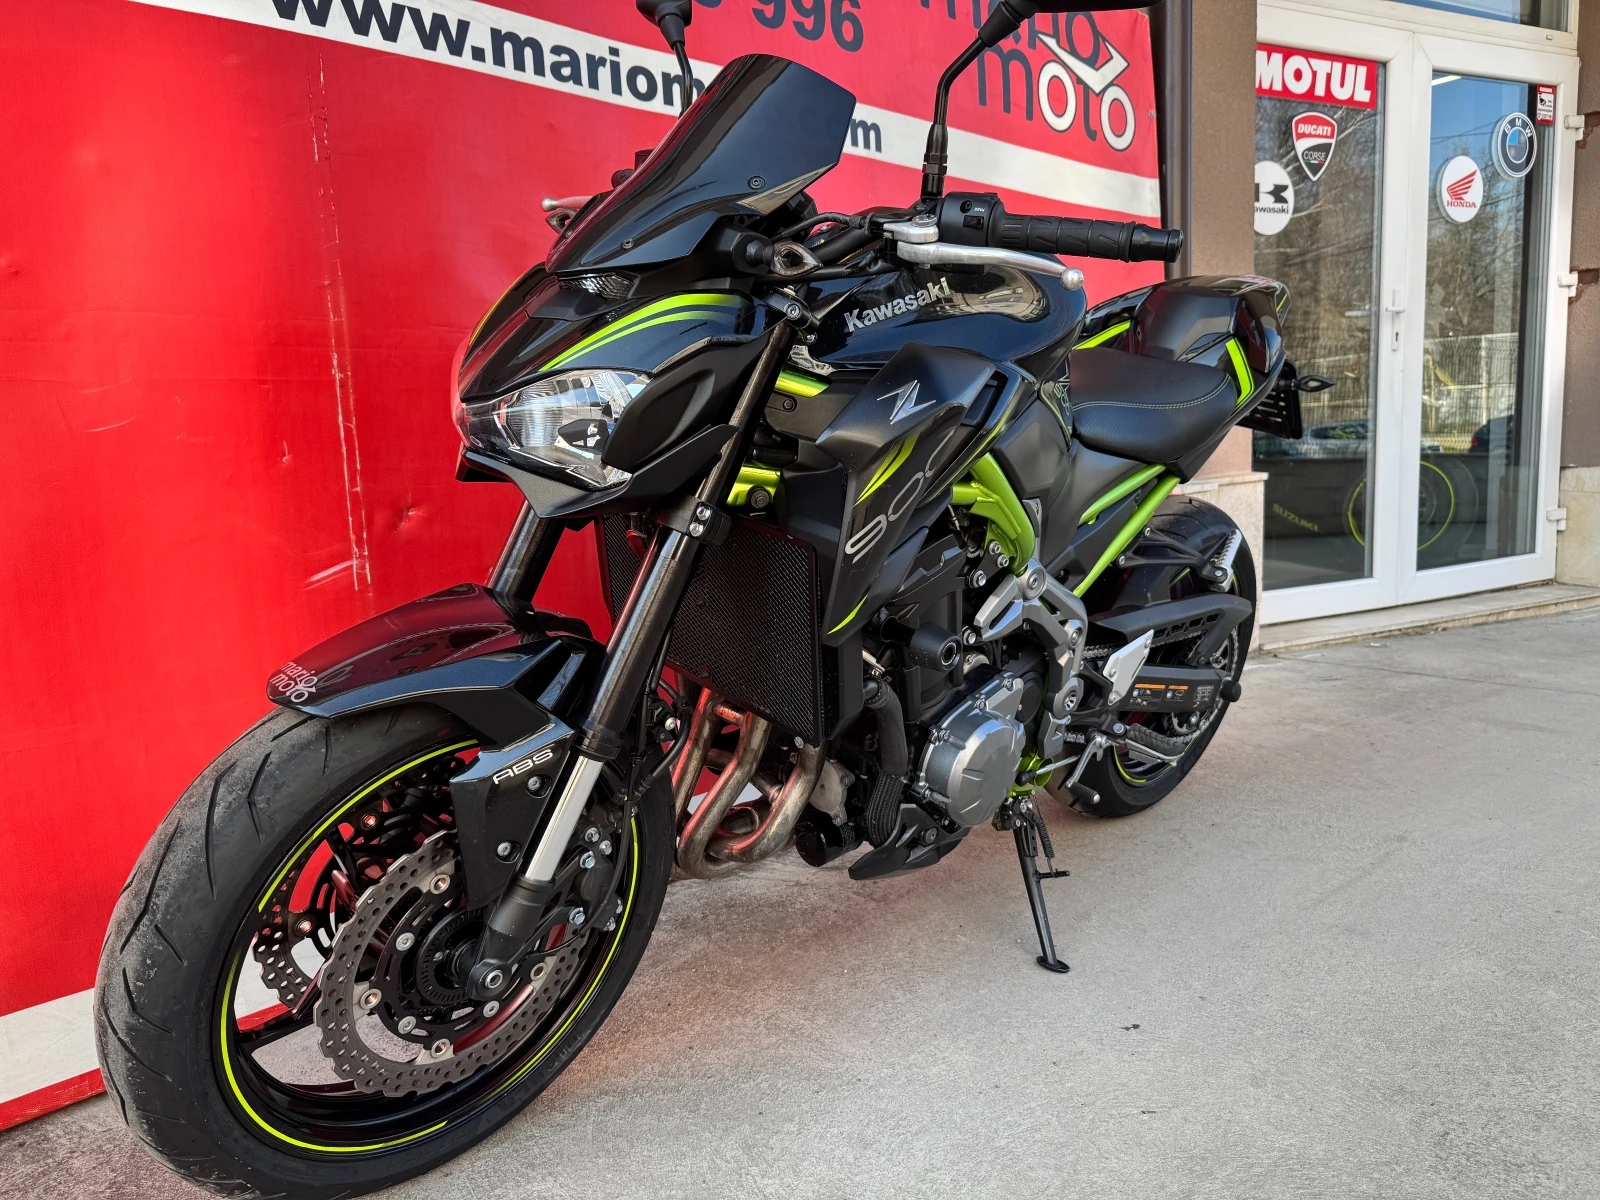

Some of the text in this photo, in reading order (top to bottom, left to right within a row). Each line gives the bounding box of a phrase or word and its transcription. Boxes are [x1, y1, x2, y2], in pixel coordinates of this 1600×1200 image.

[1256, 50, 1371, 102] MOTUL
[975, 42, 1136, 151] moto
[1297, 123, 1332, 137] DUCATI
[1504, 117, 1533, 137] BMW
[1303, 151, 1326, 162] CORSE
[1254, 205, 1289, 214] awasaki
[1446, 200, 1477, 208] HONDA
[843, 276, 950, 332] Kawasaki
[1272, 502, 1318, 532] SUZUKI
[269, 673, 309, 703] moto
[279, 661, 318, 687] mario
[492, 749, 553, 785] ABS
